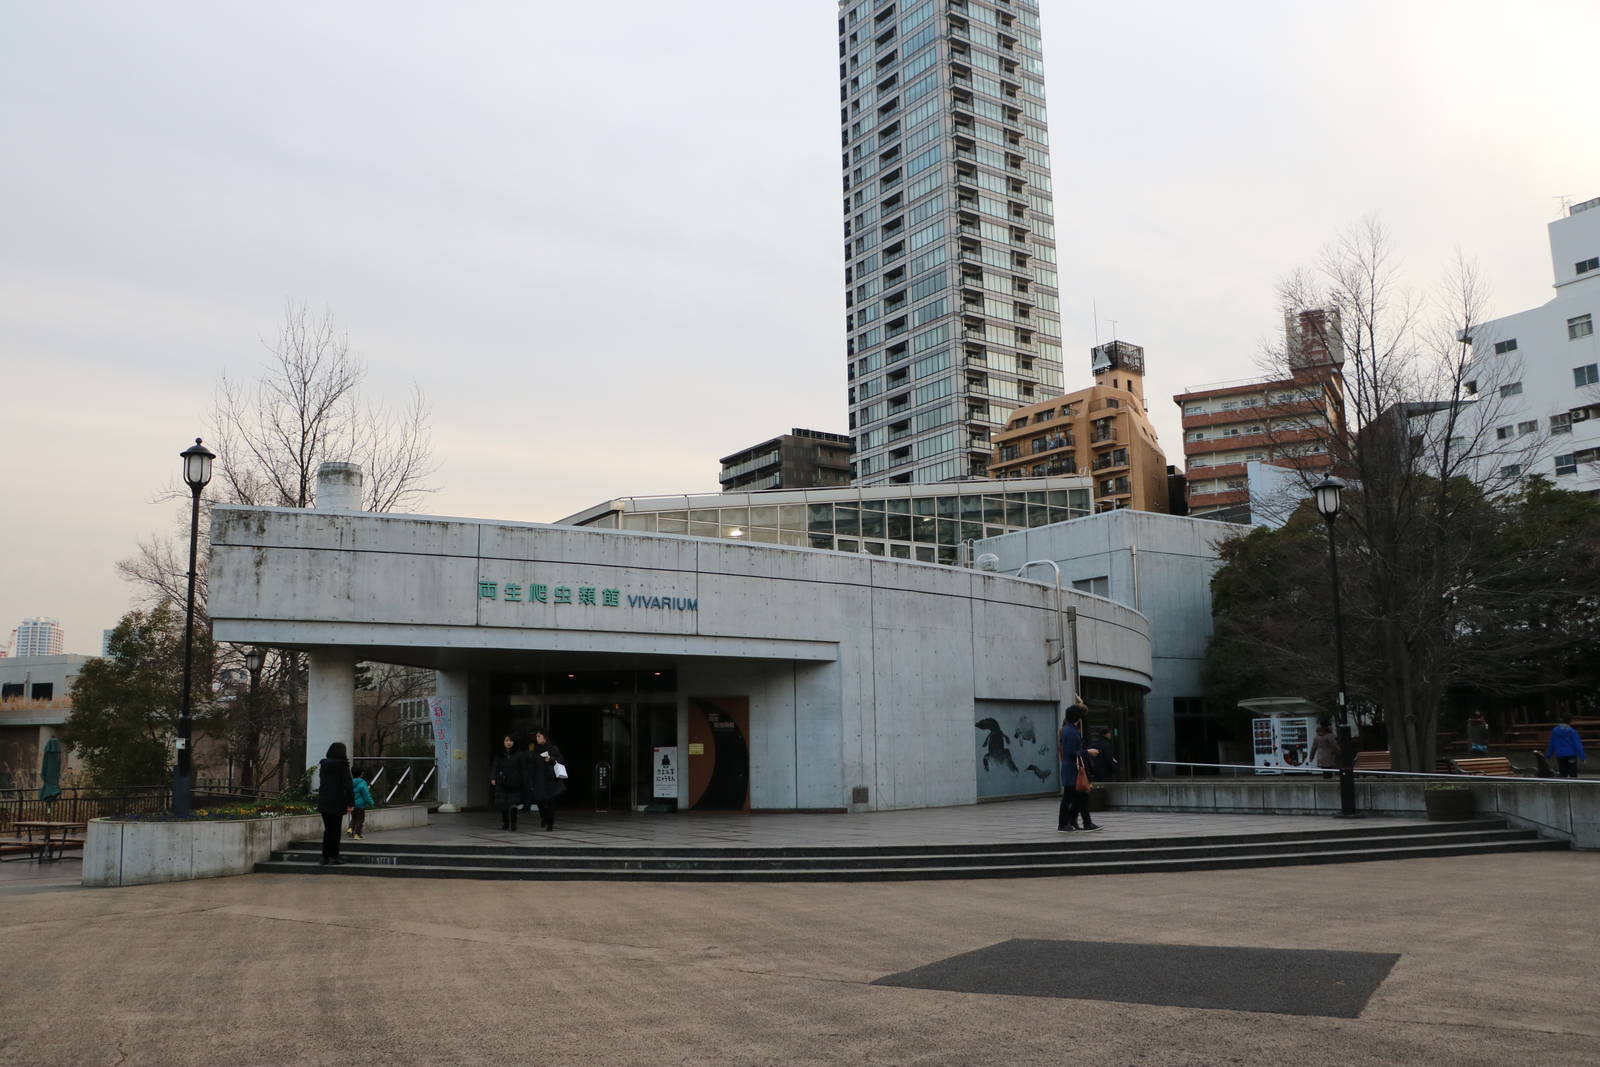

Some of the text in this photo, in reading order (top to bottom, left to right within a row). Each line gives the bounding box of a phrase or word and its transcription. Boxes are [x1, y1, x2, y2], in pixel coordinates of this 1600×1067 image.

[479, 581, 698, 611] 両生爬虫類館 VIVARIUM
